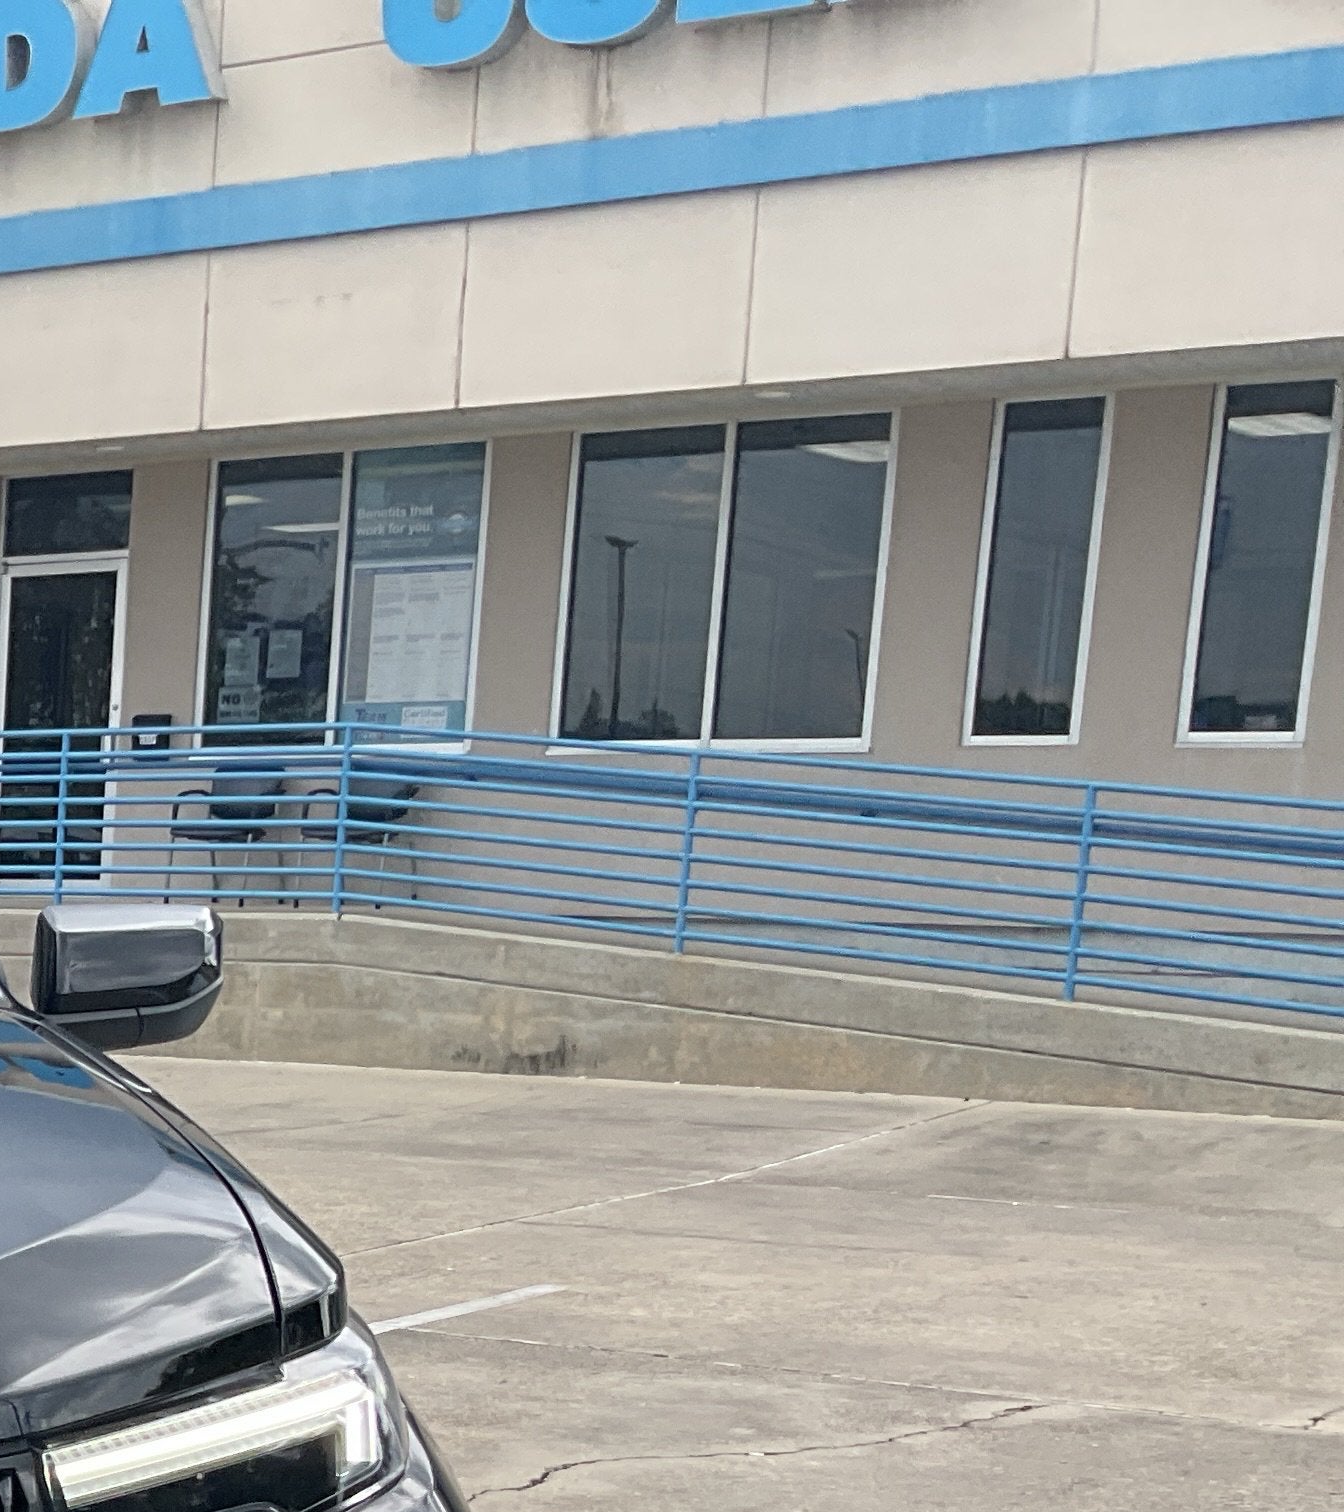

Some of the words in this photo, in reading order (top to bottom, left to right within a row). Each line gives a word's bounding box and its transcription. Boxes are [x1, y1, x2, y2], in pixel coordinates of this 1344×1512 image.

[356, 506, 407, 520] Benefits
[410, 504, 433, 517] that
[355, 524, 385, 536] work
[388, 522, 405, 534] for
